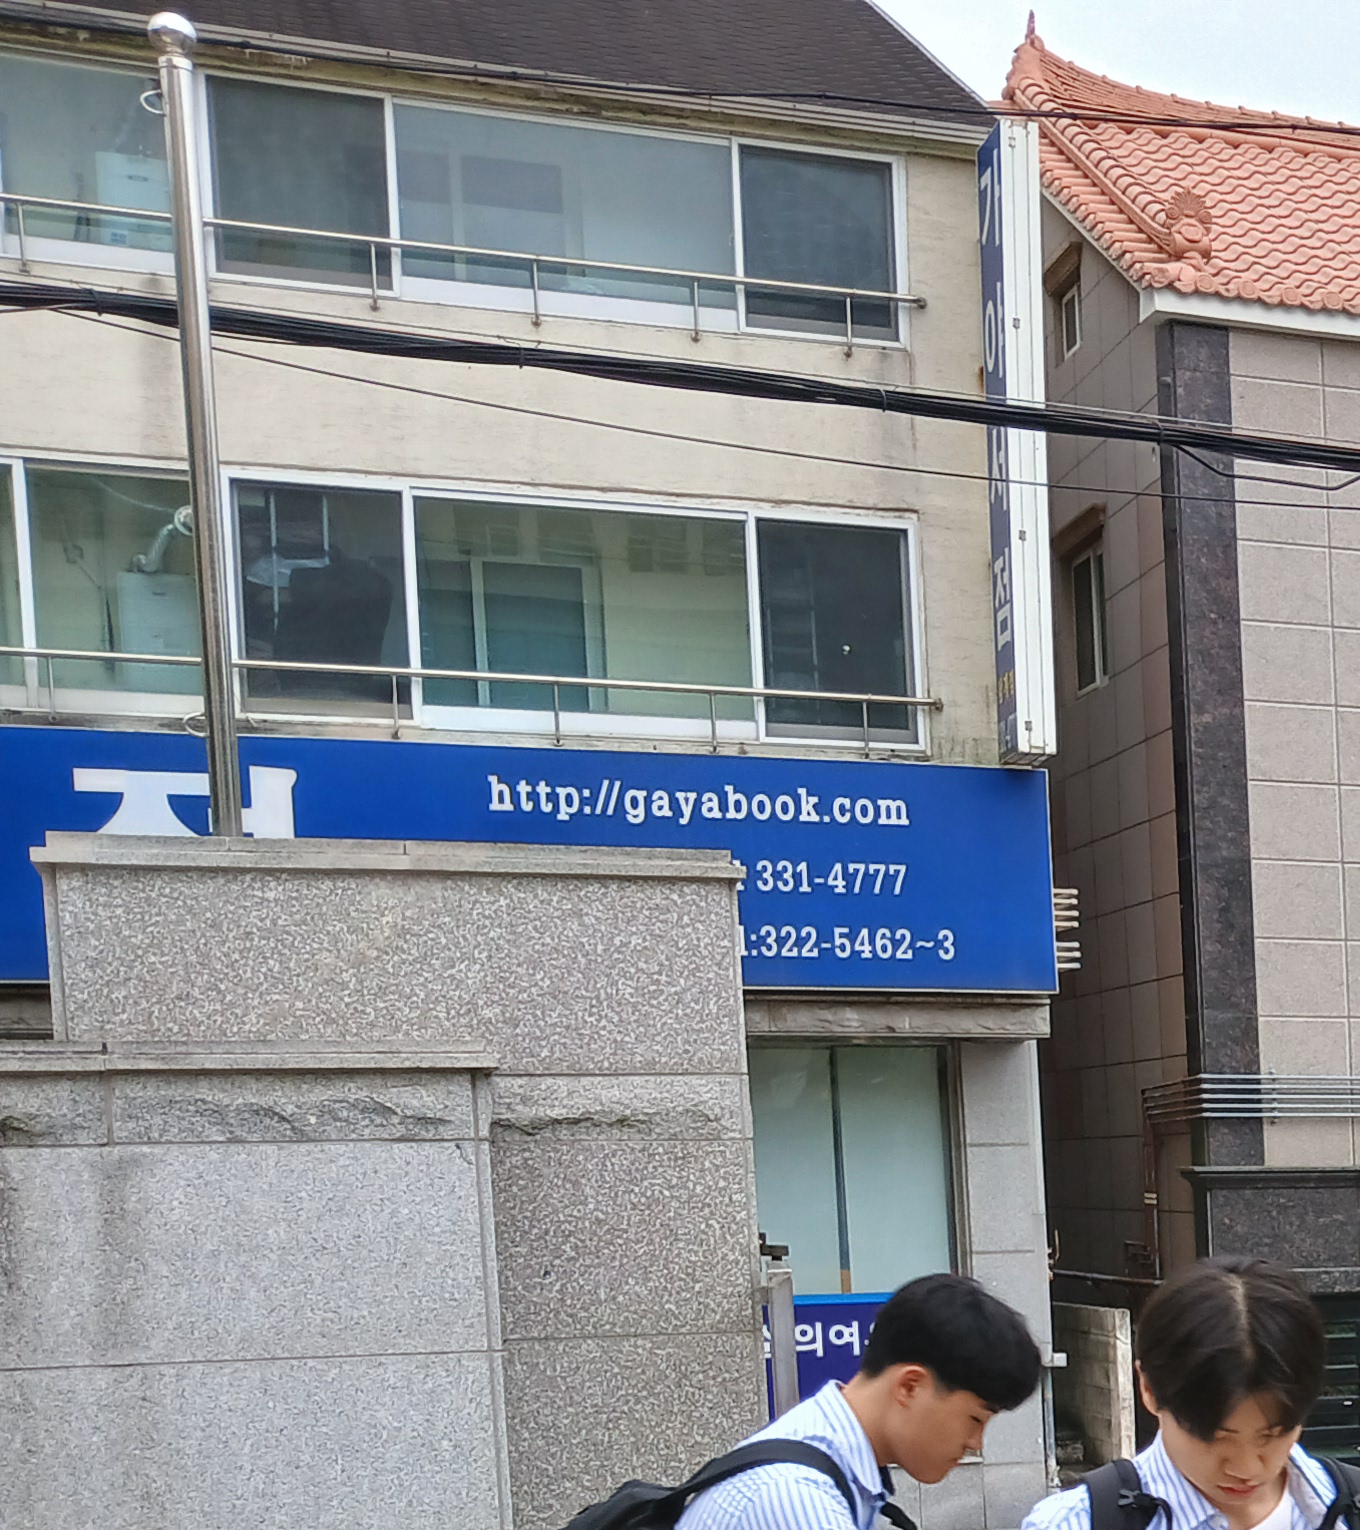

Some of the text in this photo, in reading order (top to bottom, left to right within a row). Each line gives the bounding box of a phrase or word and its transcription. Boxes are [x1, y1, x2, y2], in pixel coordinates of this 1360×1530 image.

[979, 146, 1013, 653] 가야서점
[487, 774, 910, 826] http://gayabook.com
[756, 860, 908, 896] 331-4777
